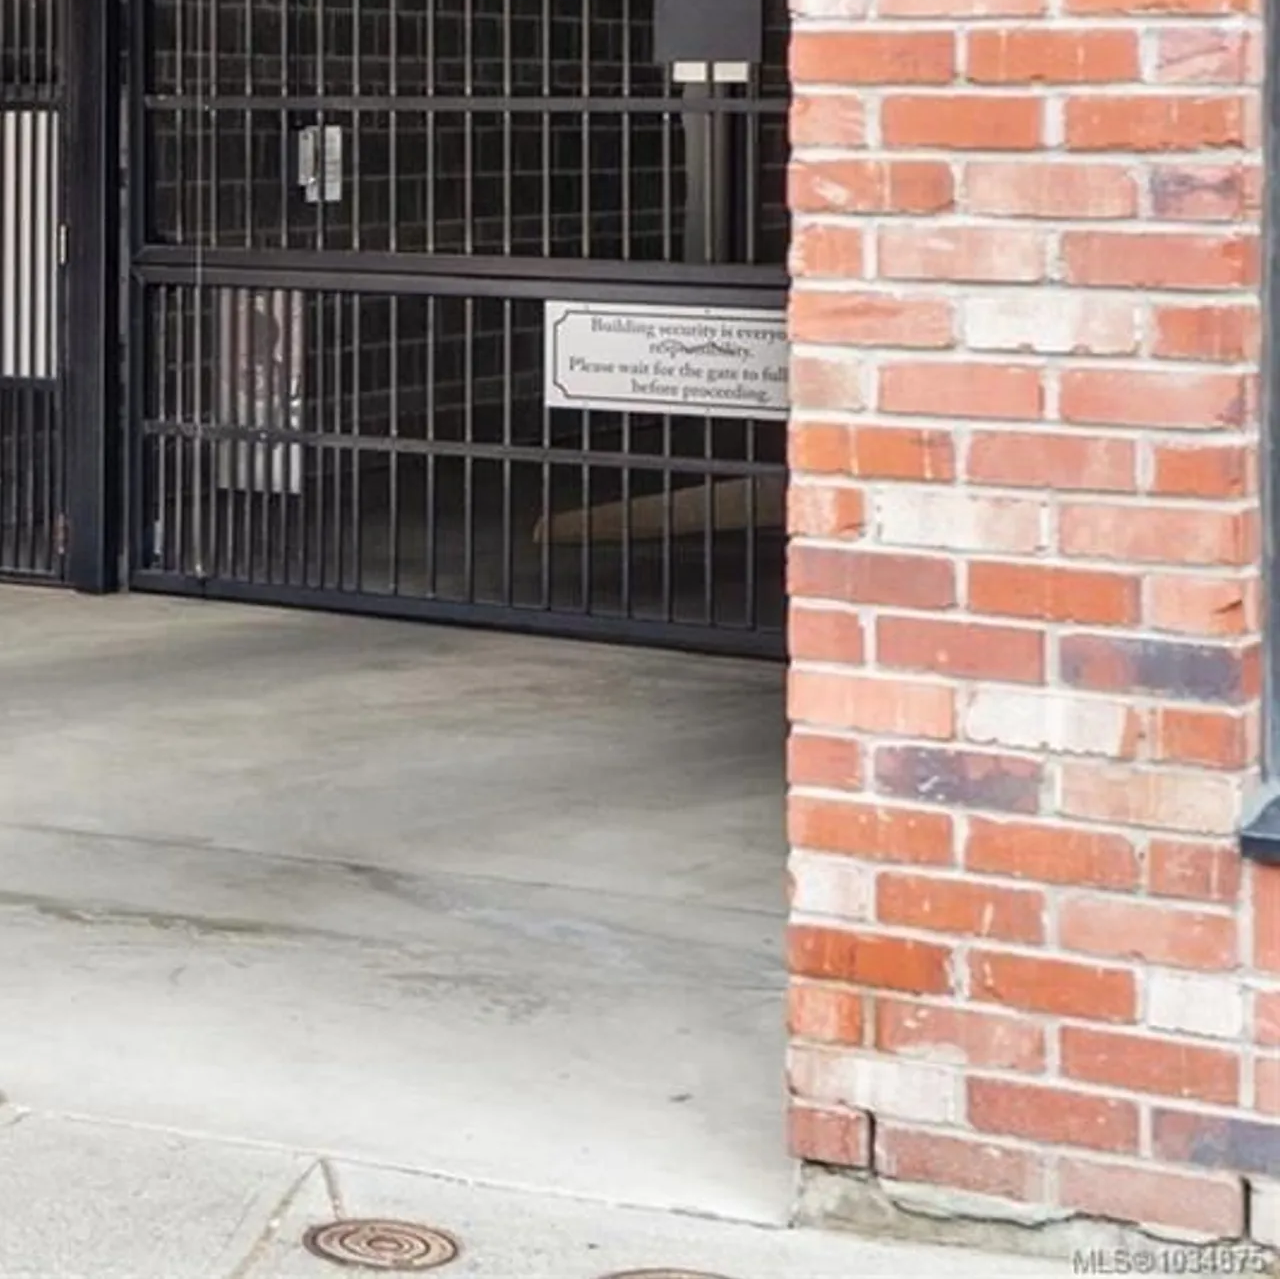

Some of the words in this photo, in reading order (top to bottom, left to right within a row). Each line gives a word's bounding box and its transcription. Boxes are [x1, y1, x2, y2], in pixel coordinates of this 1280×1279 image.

[591, 317, 654, 339] Building
[659, 323, 717, 338] security
[721, 323, 733, 338] is
[737, 328, 787, 345] everyo
[569, 356, 615, 373] Please
[618, 360, 649, 374] wait
[653, 361, 675, 377] for
[679, 364, 703, 379] the
[707, 367, 737, 382] gate
[742, 367, 759, 381] to
[762, 366, 789, 382] full
[631, 377, 678, 395] before
